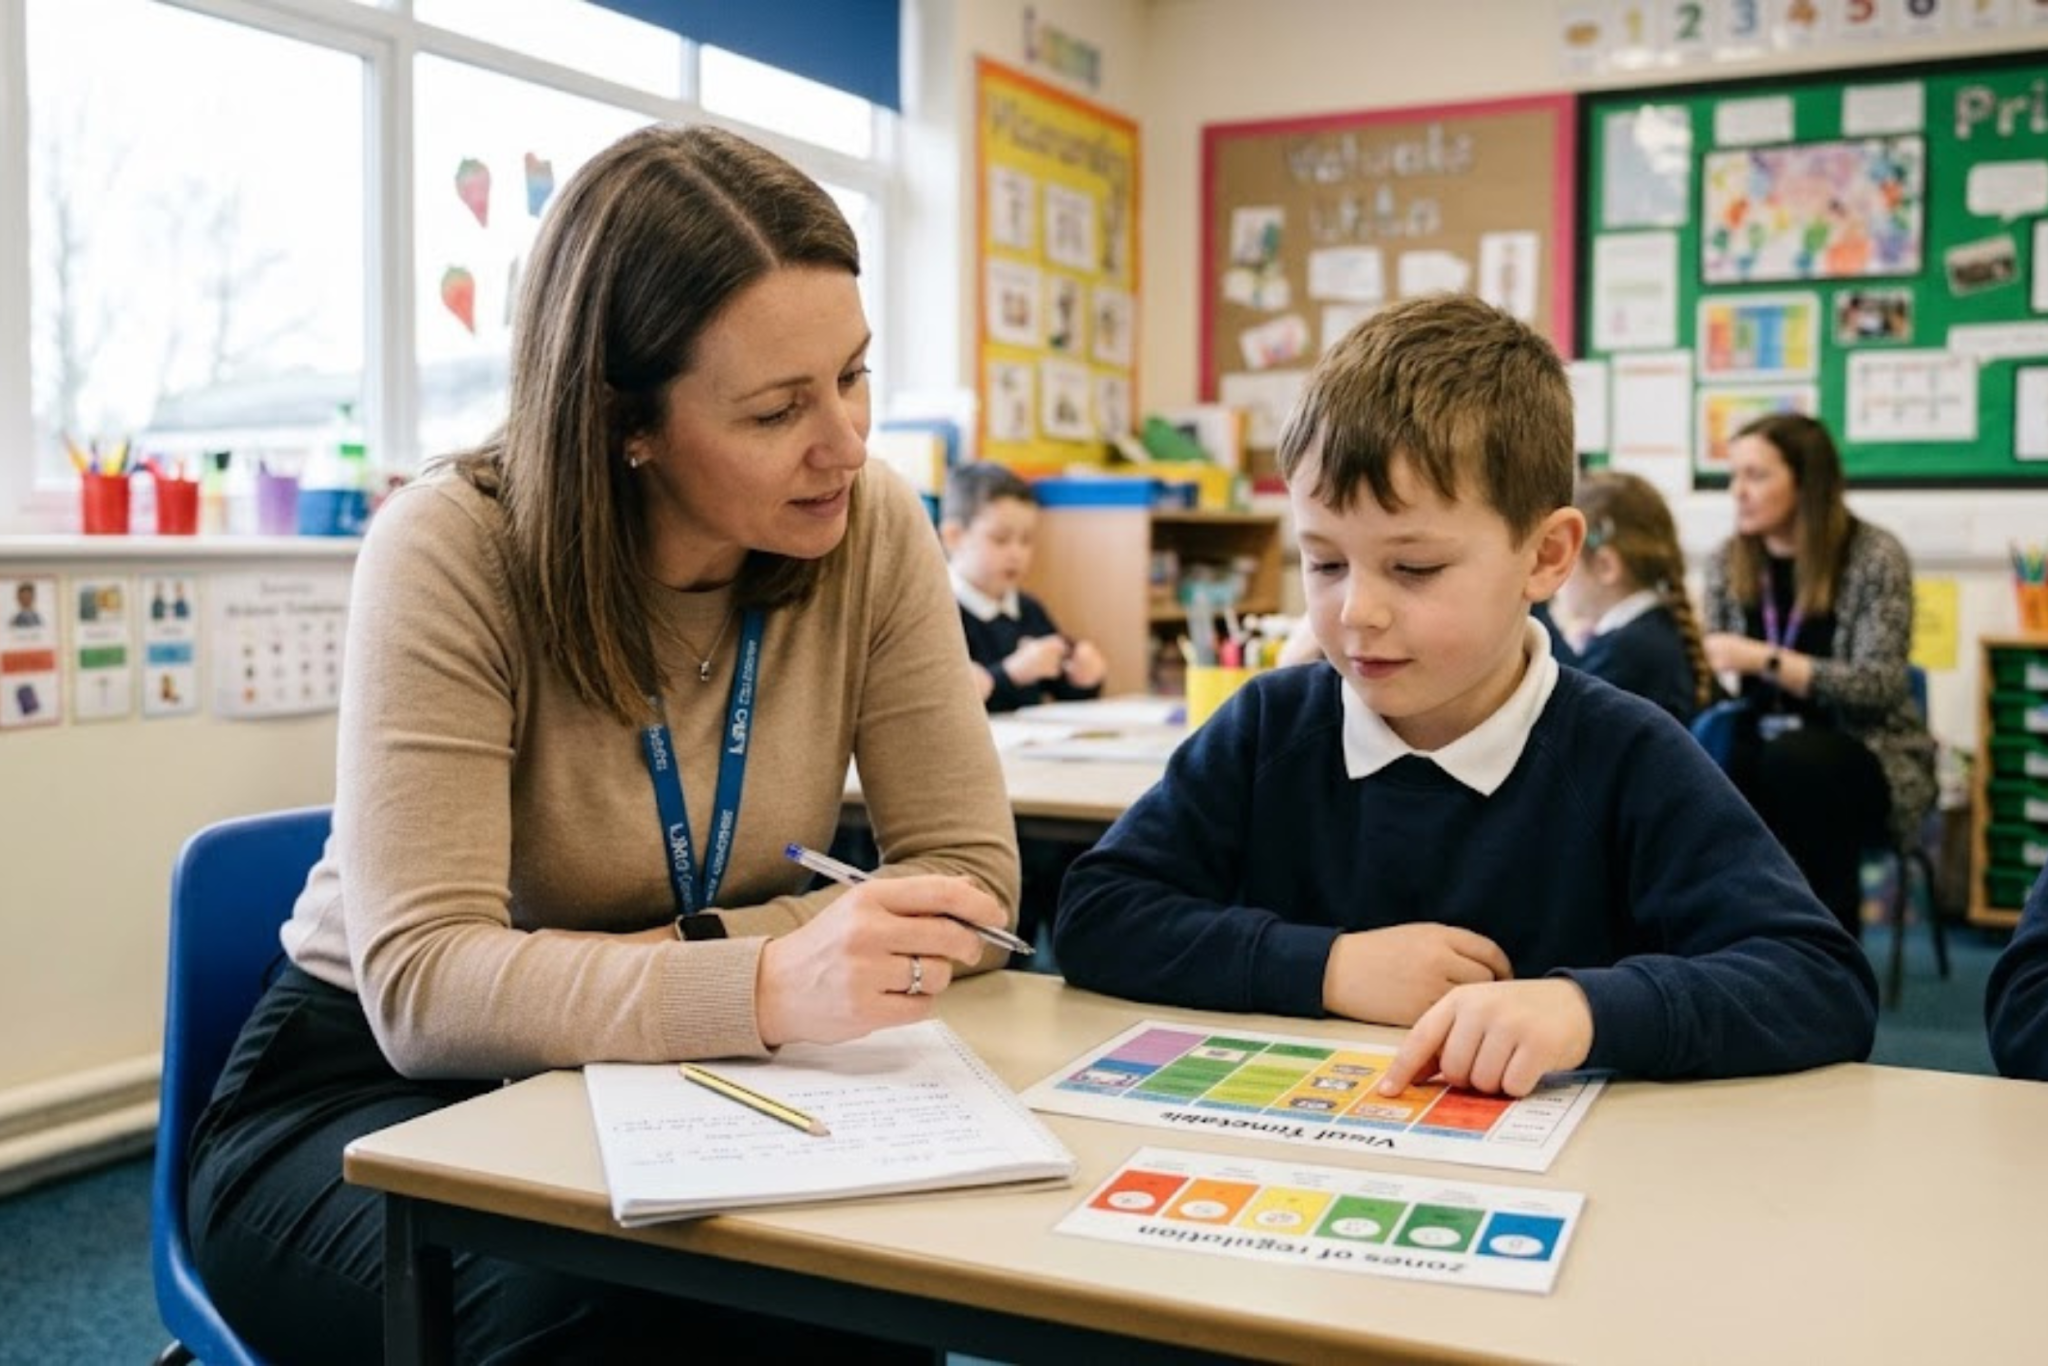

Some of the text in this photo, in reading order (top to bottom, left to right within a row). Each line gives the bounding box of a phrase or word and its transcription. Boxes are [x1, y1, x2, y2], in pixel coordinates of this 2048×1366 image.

[1674, 2, 1702, 41] 2
[1731, 0, 1758, 37] 3
[1137, 1224, 1468, 1273] zones of regulation
